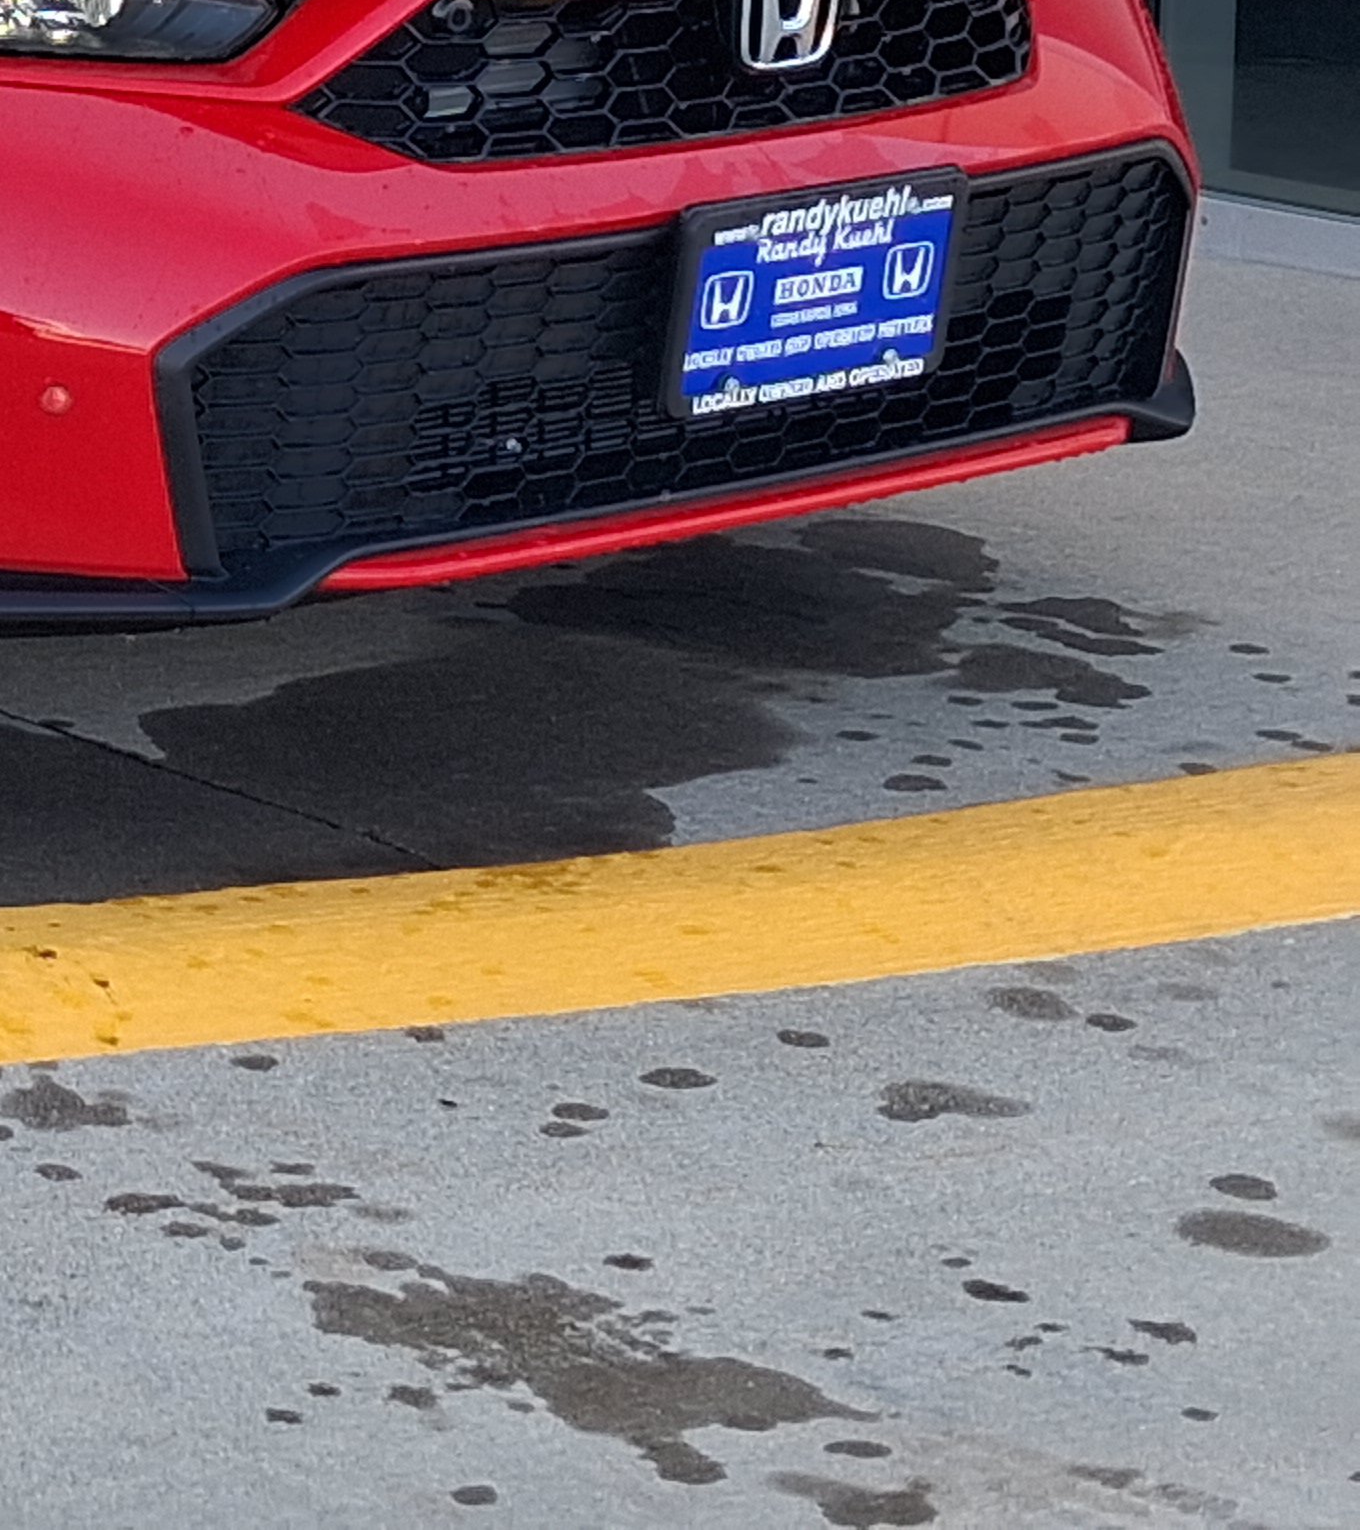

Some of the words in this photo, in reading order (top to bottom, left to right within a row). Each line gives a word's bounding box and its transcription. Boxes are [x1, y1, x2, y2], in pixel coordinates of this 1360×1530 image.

[756, 230, 827, 267] Randy
[832, 217, 896, 250] Kuehl
[779, 272, 857, 299] HONDA
